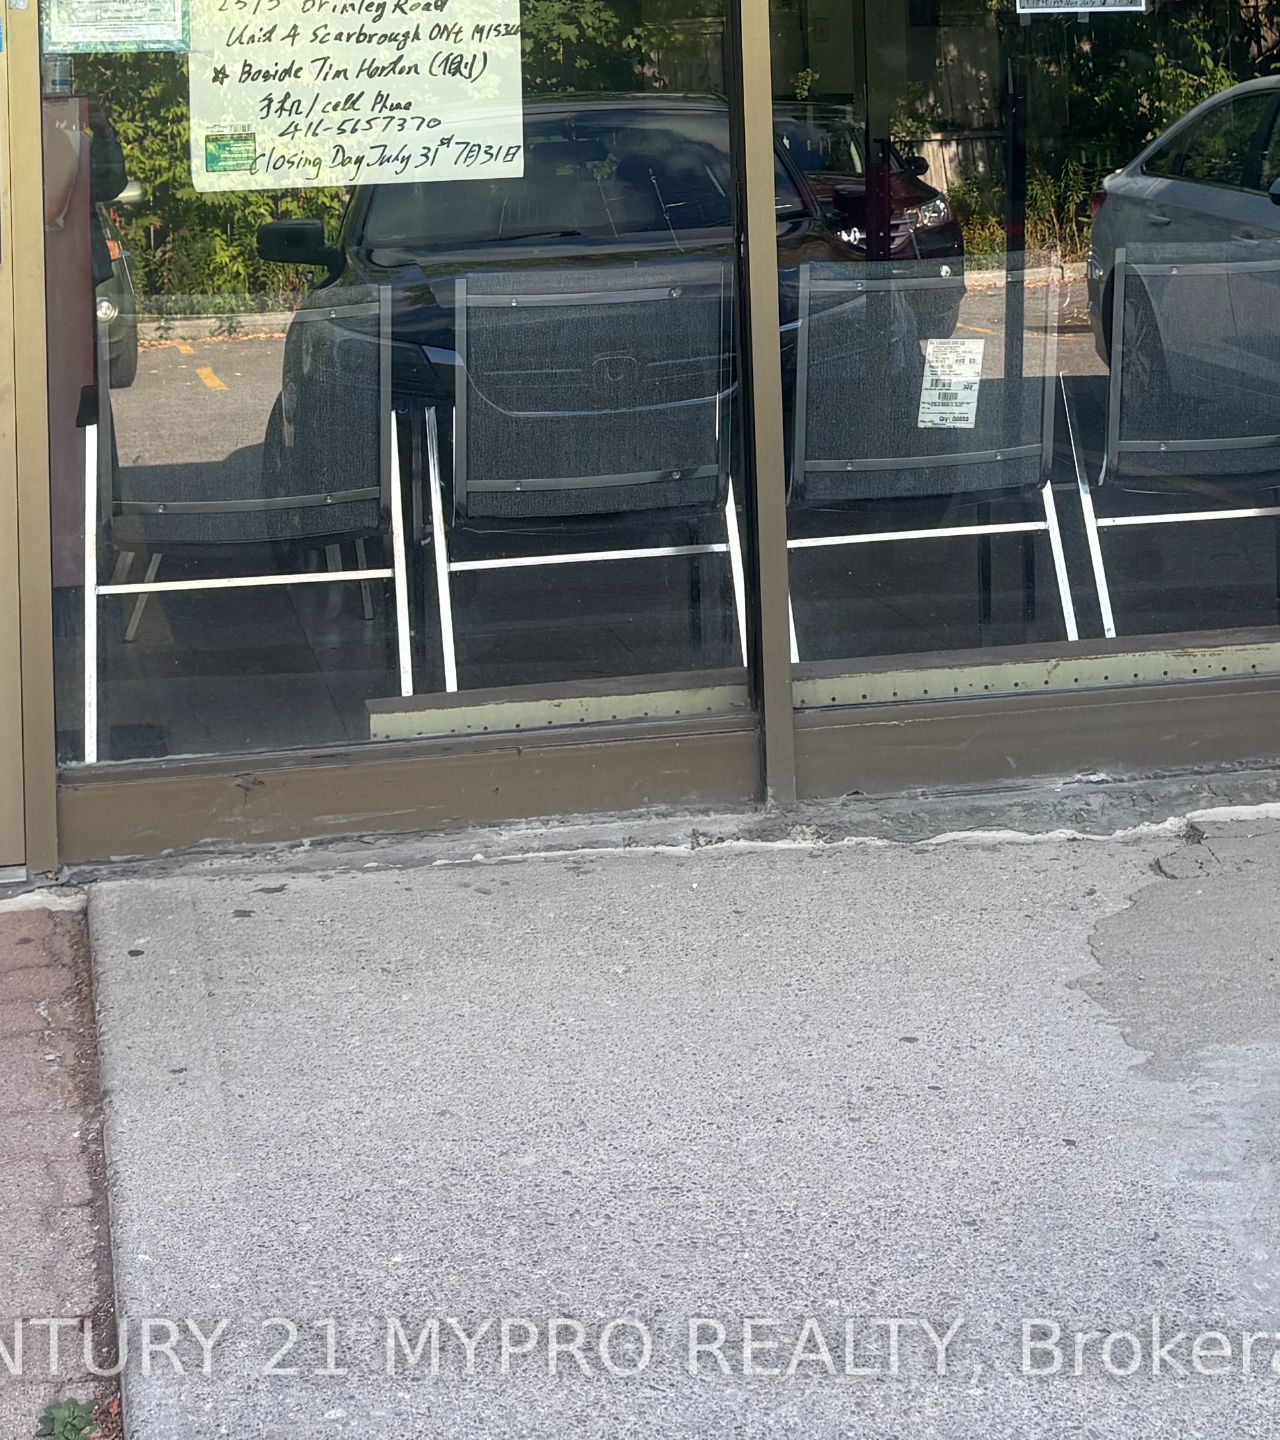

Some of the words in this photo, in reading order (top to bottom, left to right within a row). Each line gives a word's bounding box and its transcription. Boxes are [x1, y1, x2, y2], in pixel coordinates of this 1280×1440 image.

[310, 55, 350, 81] Tim
[329, 144, 368, 182] Day
[366, 143, 413, 178] July
